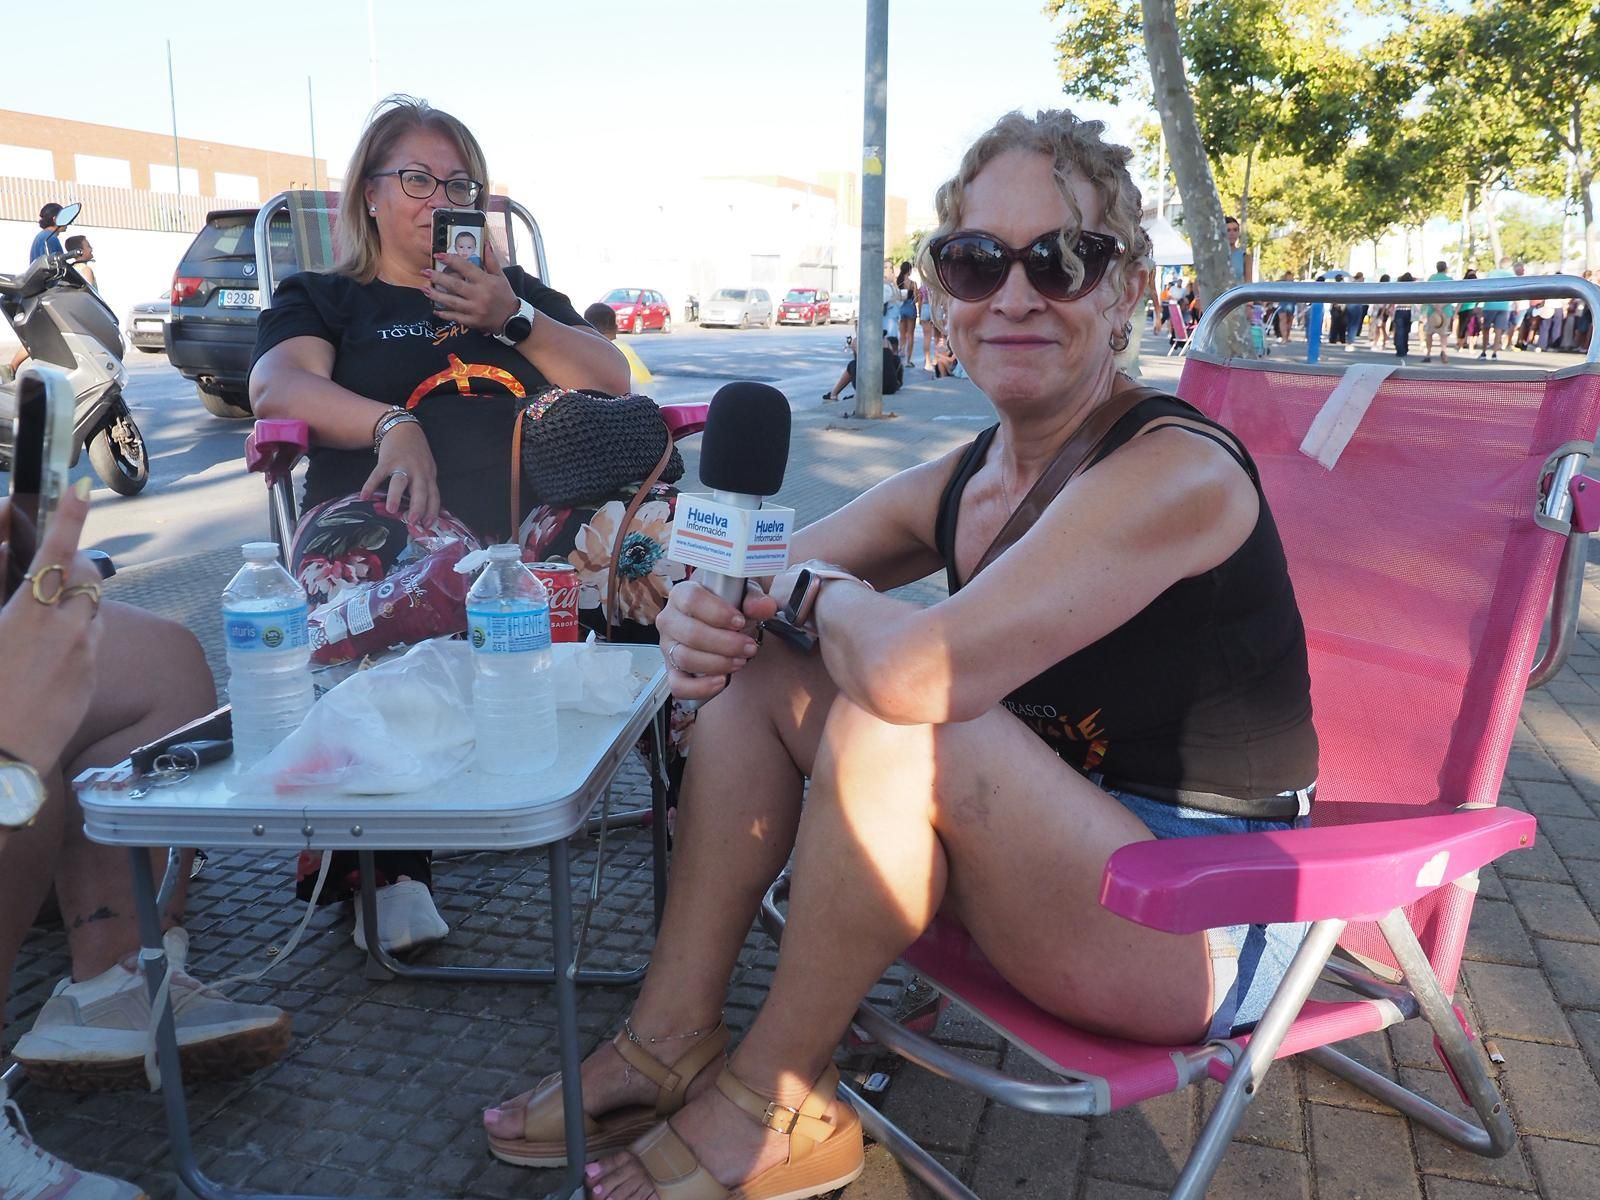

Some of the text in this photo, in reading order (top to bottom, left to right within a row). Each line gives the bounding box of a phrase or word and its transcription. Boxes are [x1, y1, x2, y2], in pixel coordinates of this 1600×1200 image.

[226, 292, 254, 304] 9298
[688, 506, 728, 529] Huelva
[686, 520, 727, 538] Información
[755, 520, 784, 534] Huelva
[754, 534, 783, 542] Información
[512, 613, 542, 637] FUENTE
